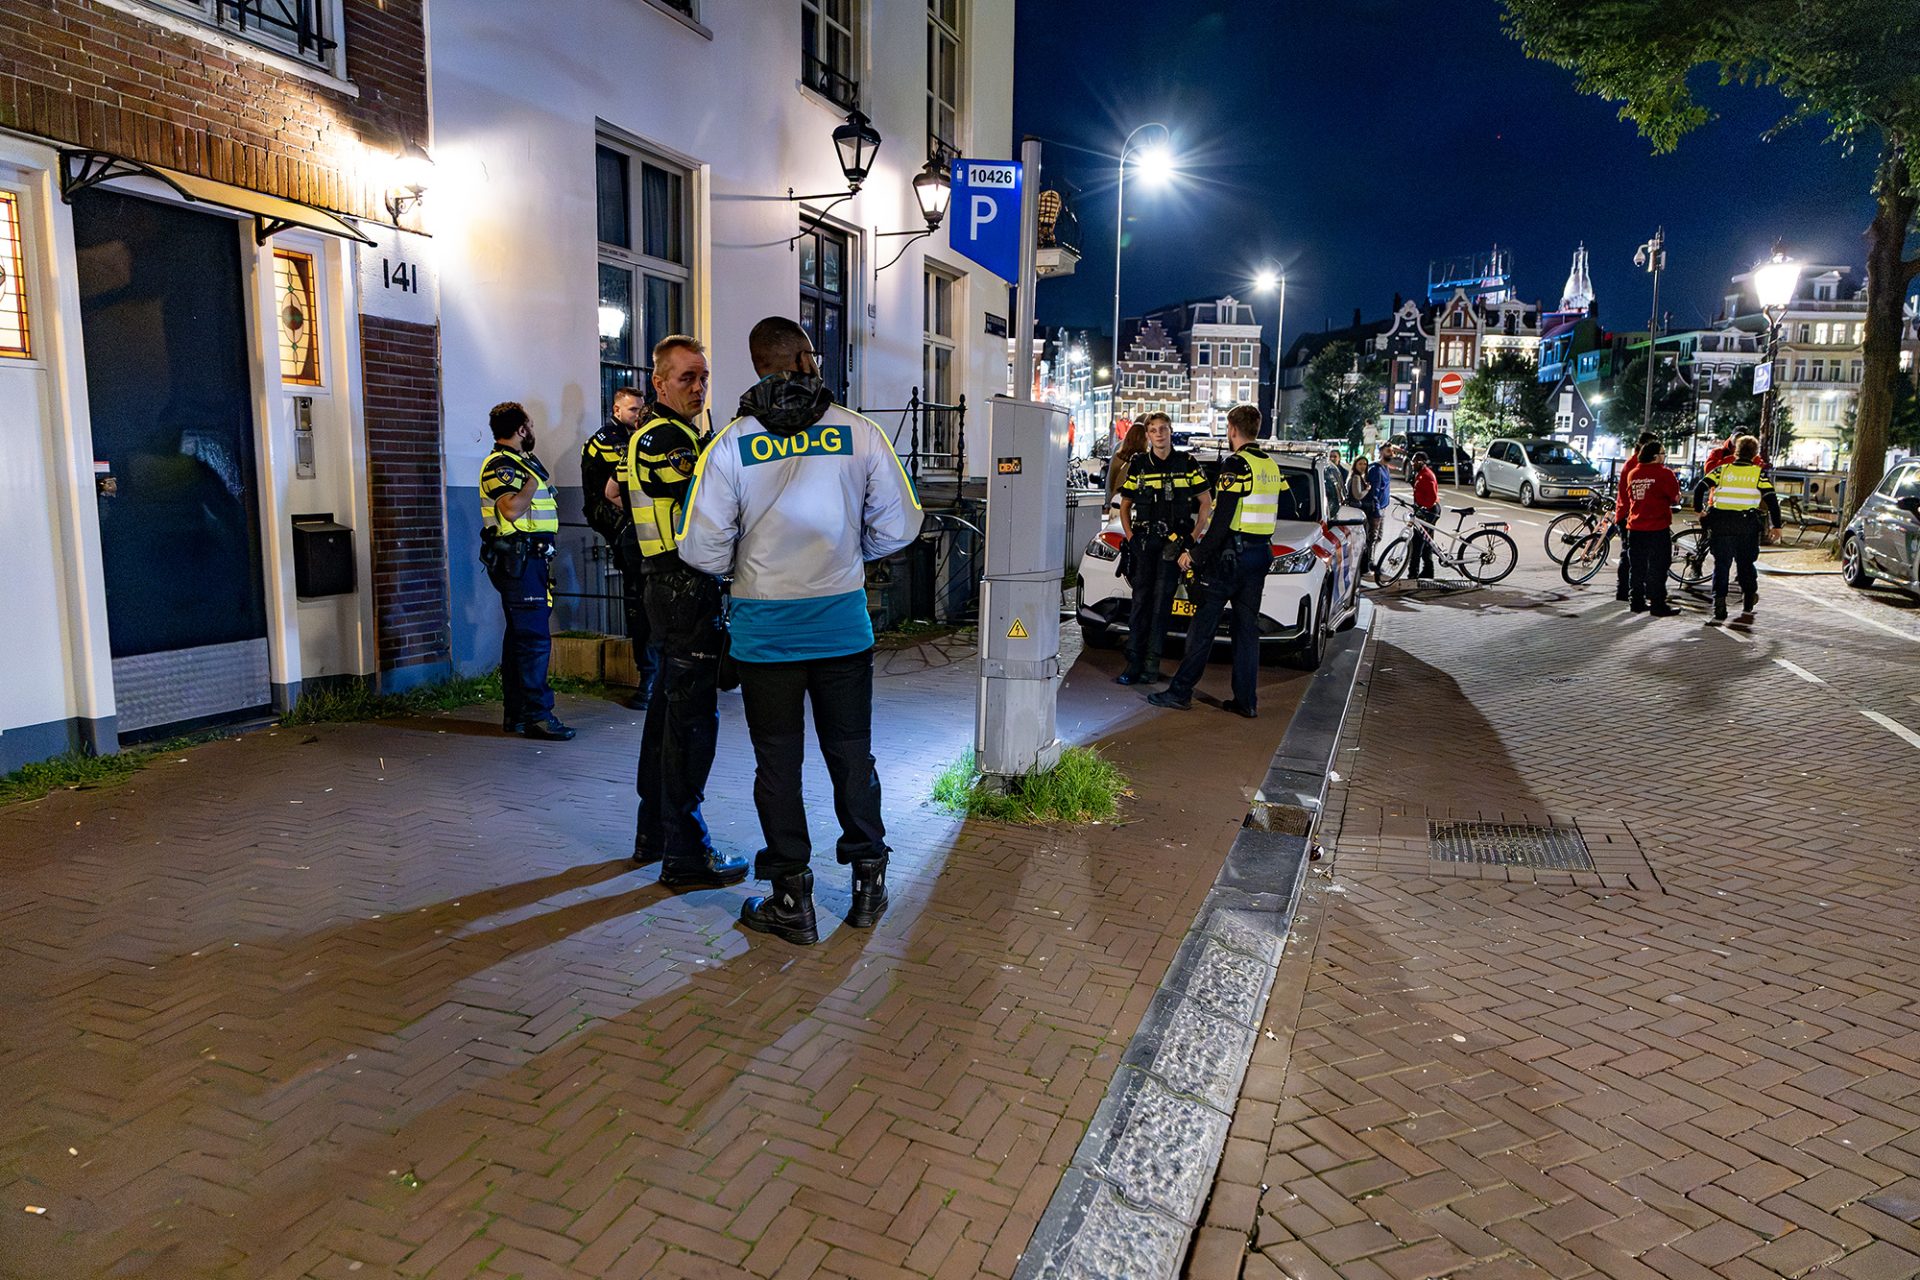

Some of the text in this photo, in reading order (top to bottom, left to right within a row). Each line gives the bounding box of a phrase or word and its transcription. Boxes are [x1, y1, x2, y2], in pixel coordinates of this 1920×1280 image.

[970, 169, 1013, 184] 10426
[970, 195, 998, 240] P
[383, 258, 417, 294] 141
[751, 427, 842, 460] OvD-G
